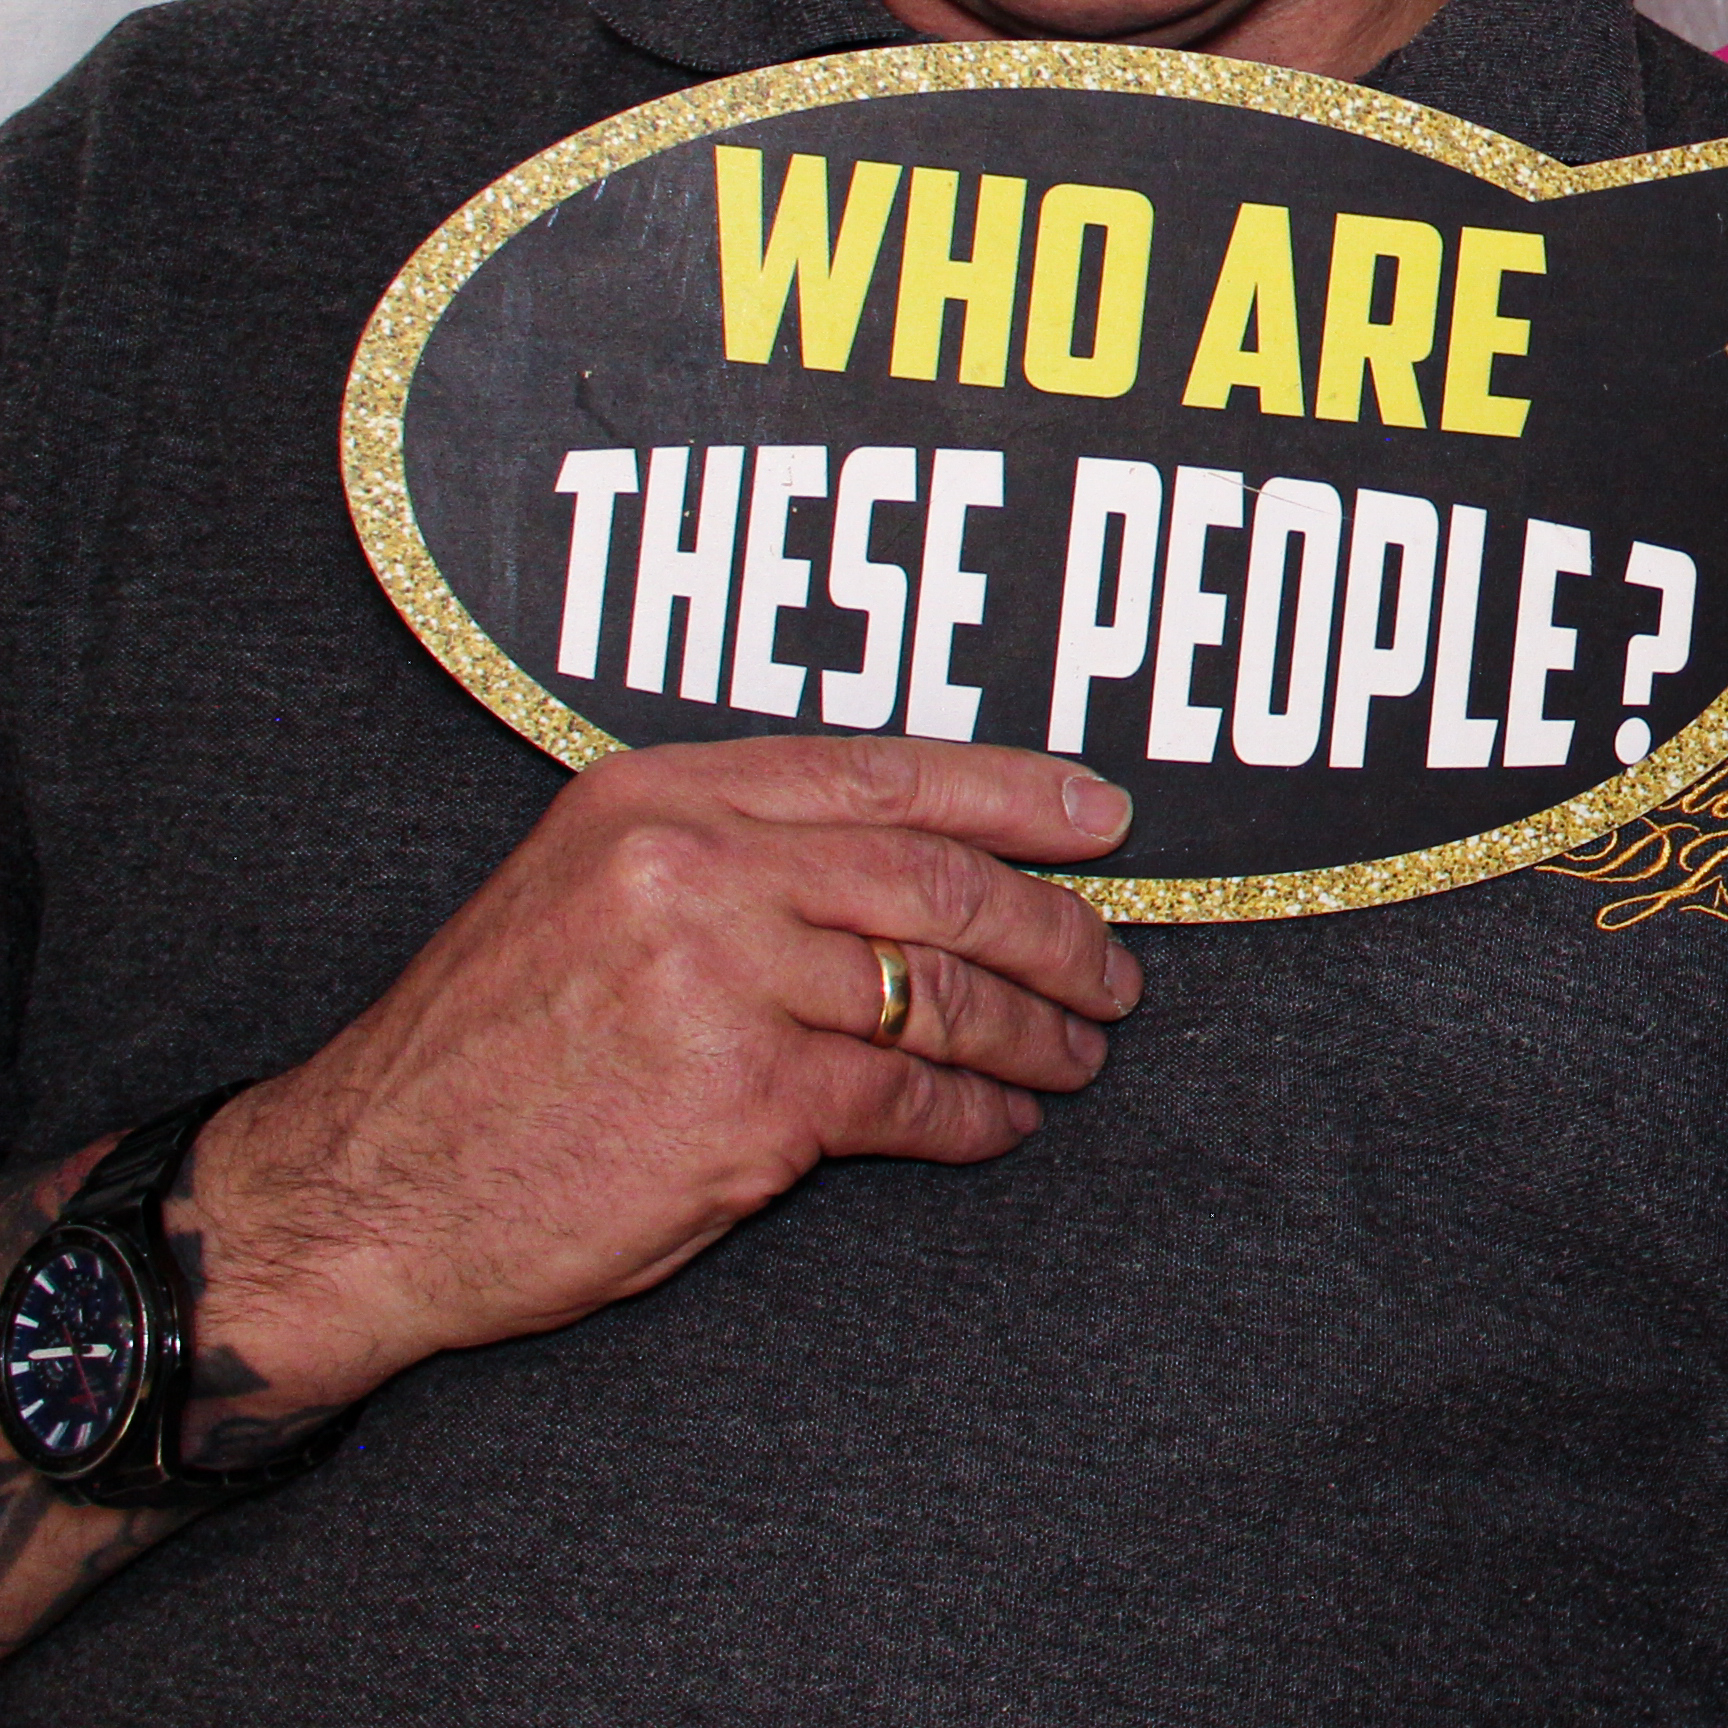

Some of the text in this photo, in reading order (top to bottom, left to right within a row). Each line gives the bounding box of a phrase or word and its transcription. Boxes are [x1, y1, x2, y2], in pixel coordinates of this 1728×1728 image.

[715, 144, 1547, 439] WHO ARE
[554, 445, 1004, 743] THESE
